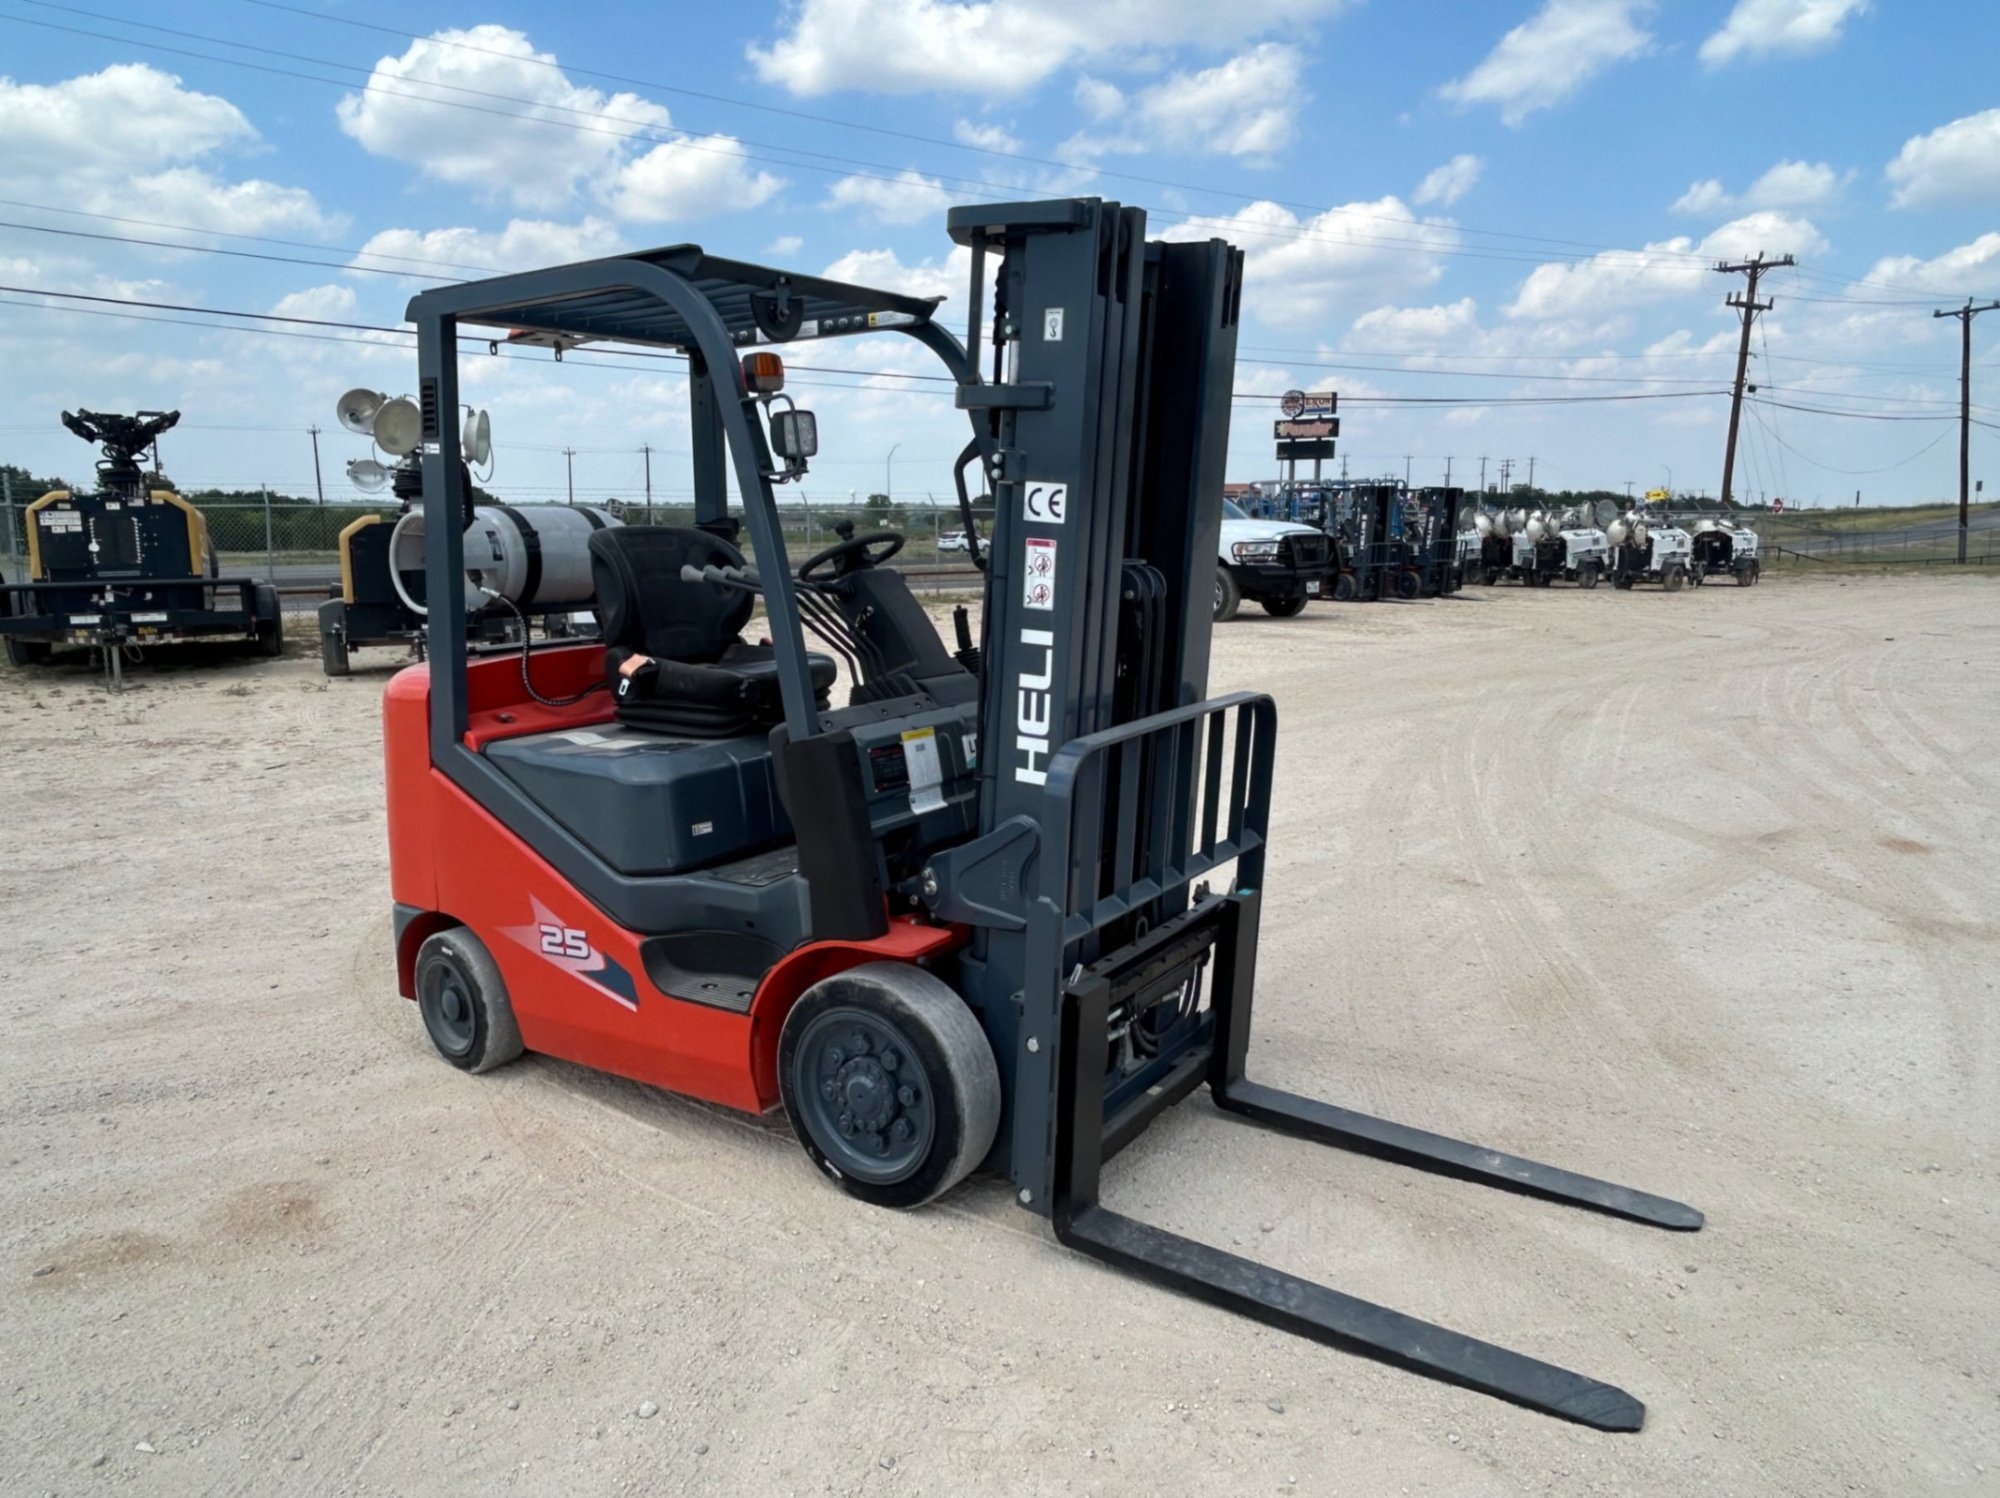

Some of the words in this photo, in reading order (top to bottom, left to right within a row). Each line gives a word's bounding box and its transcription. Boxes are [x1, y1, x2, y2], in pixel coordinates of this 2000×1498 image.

[1028, 487, 1063, 518] CE
[1015, 628, 1053, 786] HELI
[540, 923, 590, 960] 25
